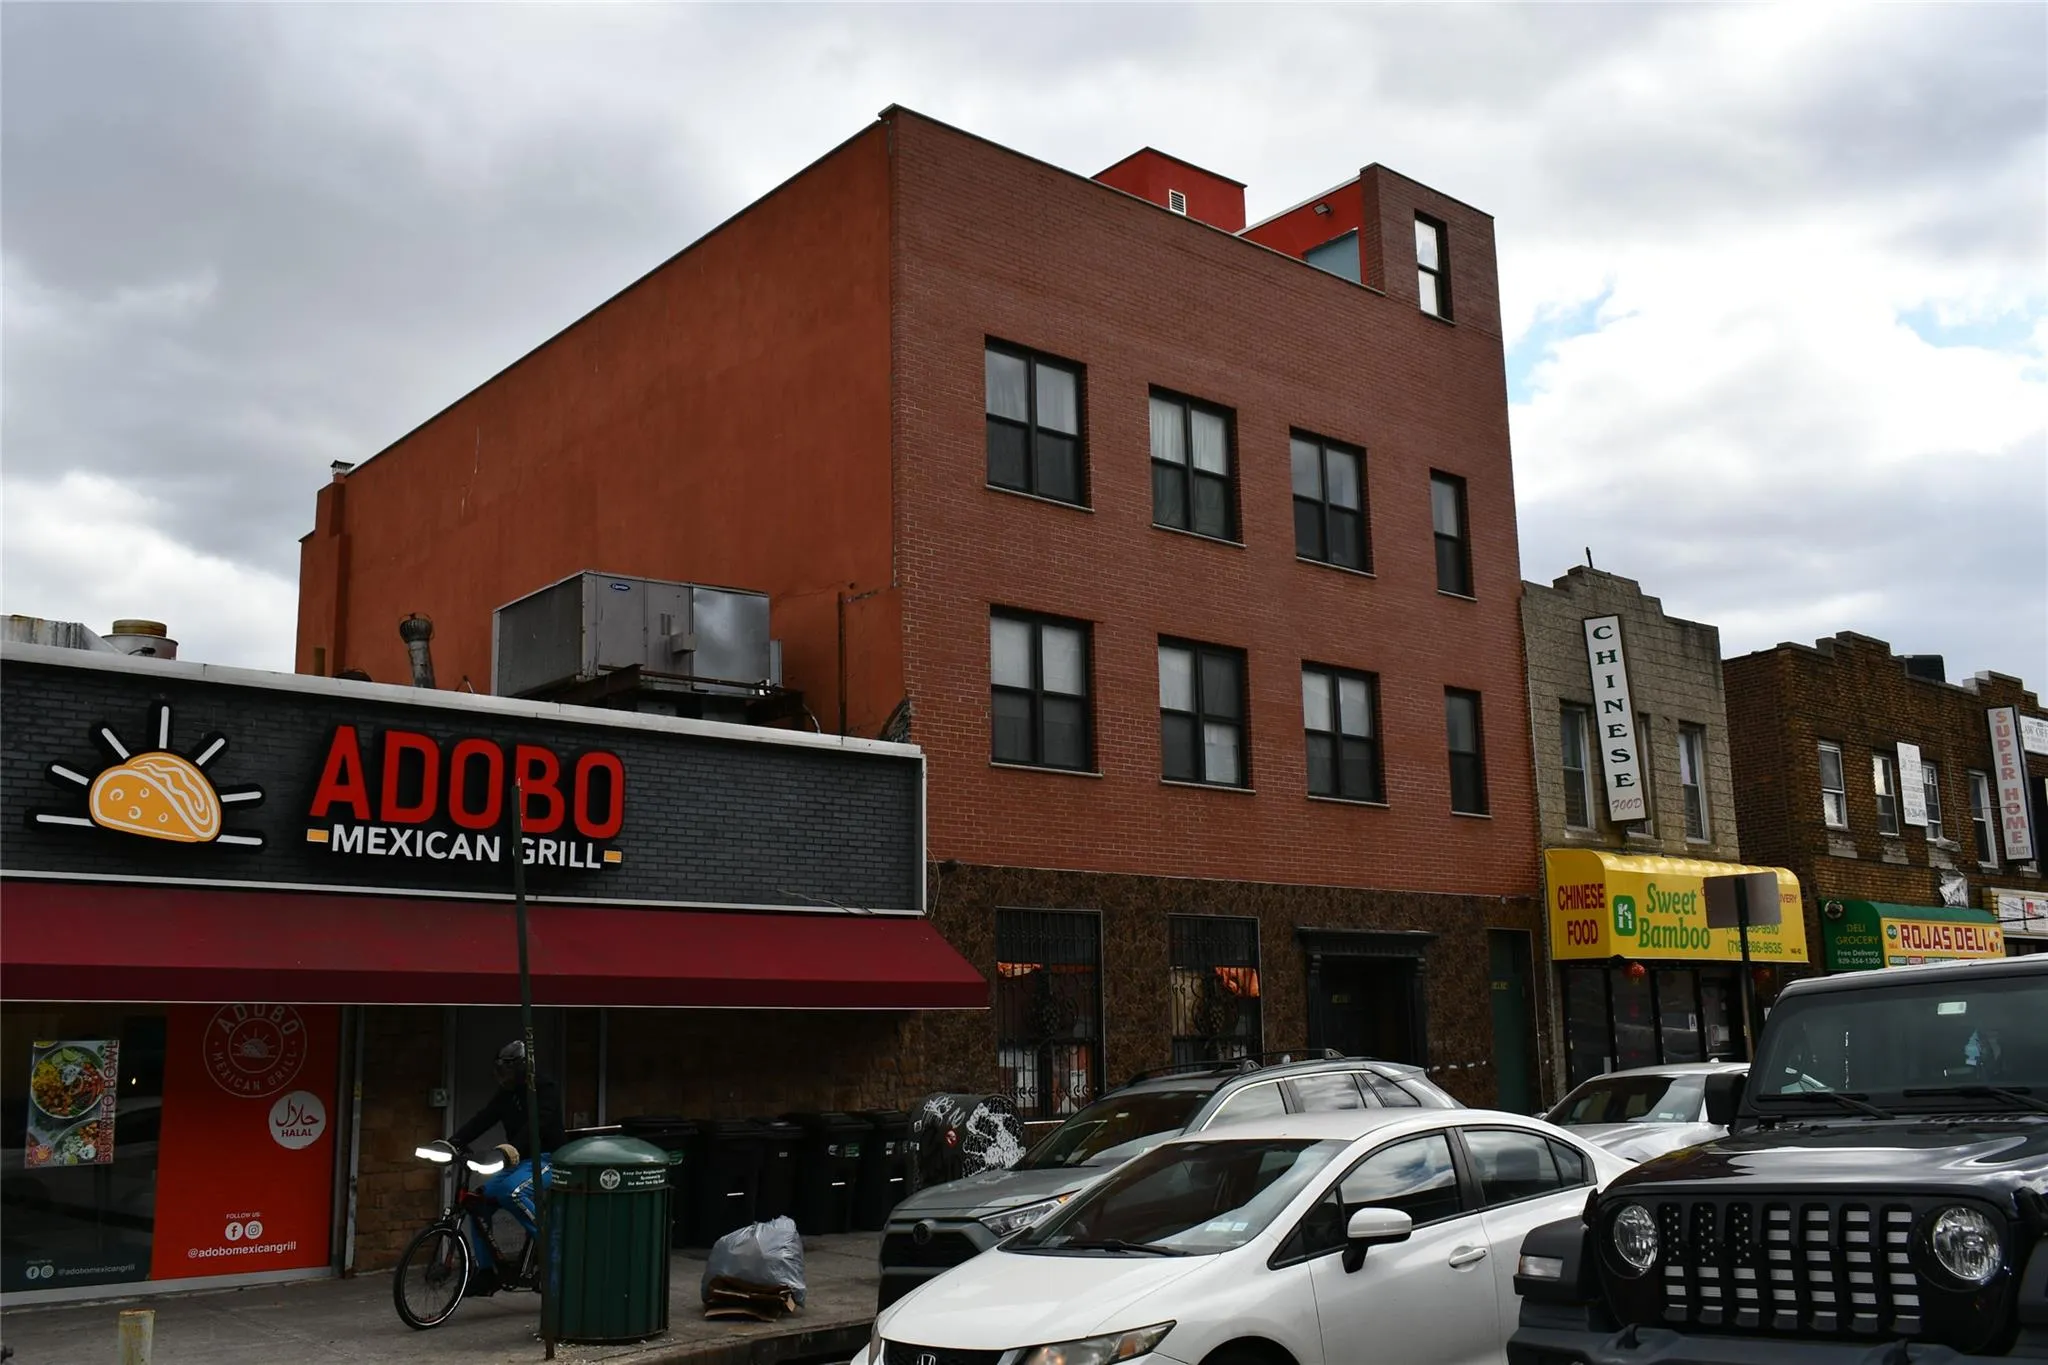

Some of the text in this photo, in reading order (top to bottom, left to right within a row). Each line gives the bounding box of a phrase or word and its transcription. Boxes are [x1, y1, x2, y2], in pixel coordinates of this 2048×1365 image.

[1593, 625, 1635, 788] CHINESE
[309, 725, 625, 838] ADOBO
[1995, 711, 2026, 844] SUPER HOME
[1611, 797, 1643, 814] FOOD
[332, 824, 601, 868] MEXICAN GRILL
[1557, 883, 1606, 911] CHINESE
[1646, 882, 1697, 915] Sweet
[1567, 919, 1599, 945] FOOD
[1638, 917, 1711, 949] Bamboo
[1836, 935, 1879, 945] GROCERY
[1847, 924, 1866, 933] DELI
[1900, 924, 1950, 950] ROJAS
[1954, 927, 1988, 951] DELI
[1852, 949, 1879, 958] Delivery
[218, 1004, 299, 1034] ADOBO
[212, 1052, 297, 1090] MEXICAN GRILL
[275, 1099, 320, 1127] حلال
[281, 1128, 313, 1137] HALAL
[187, 1241, 297, 1259] @adobomexicangrill
